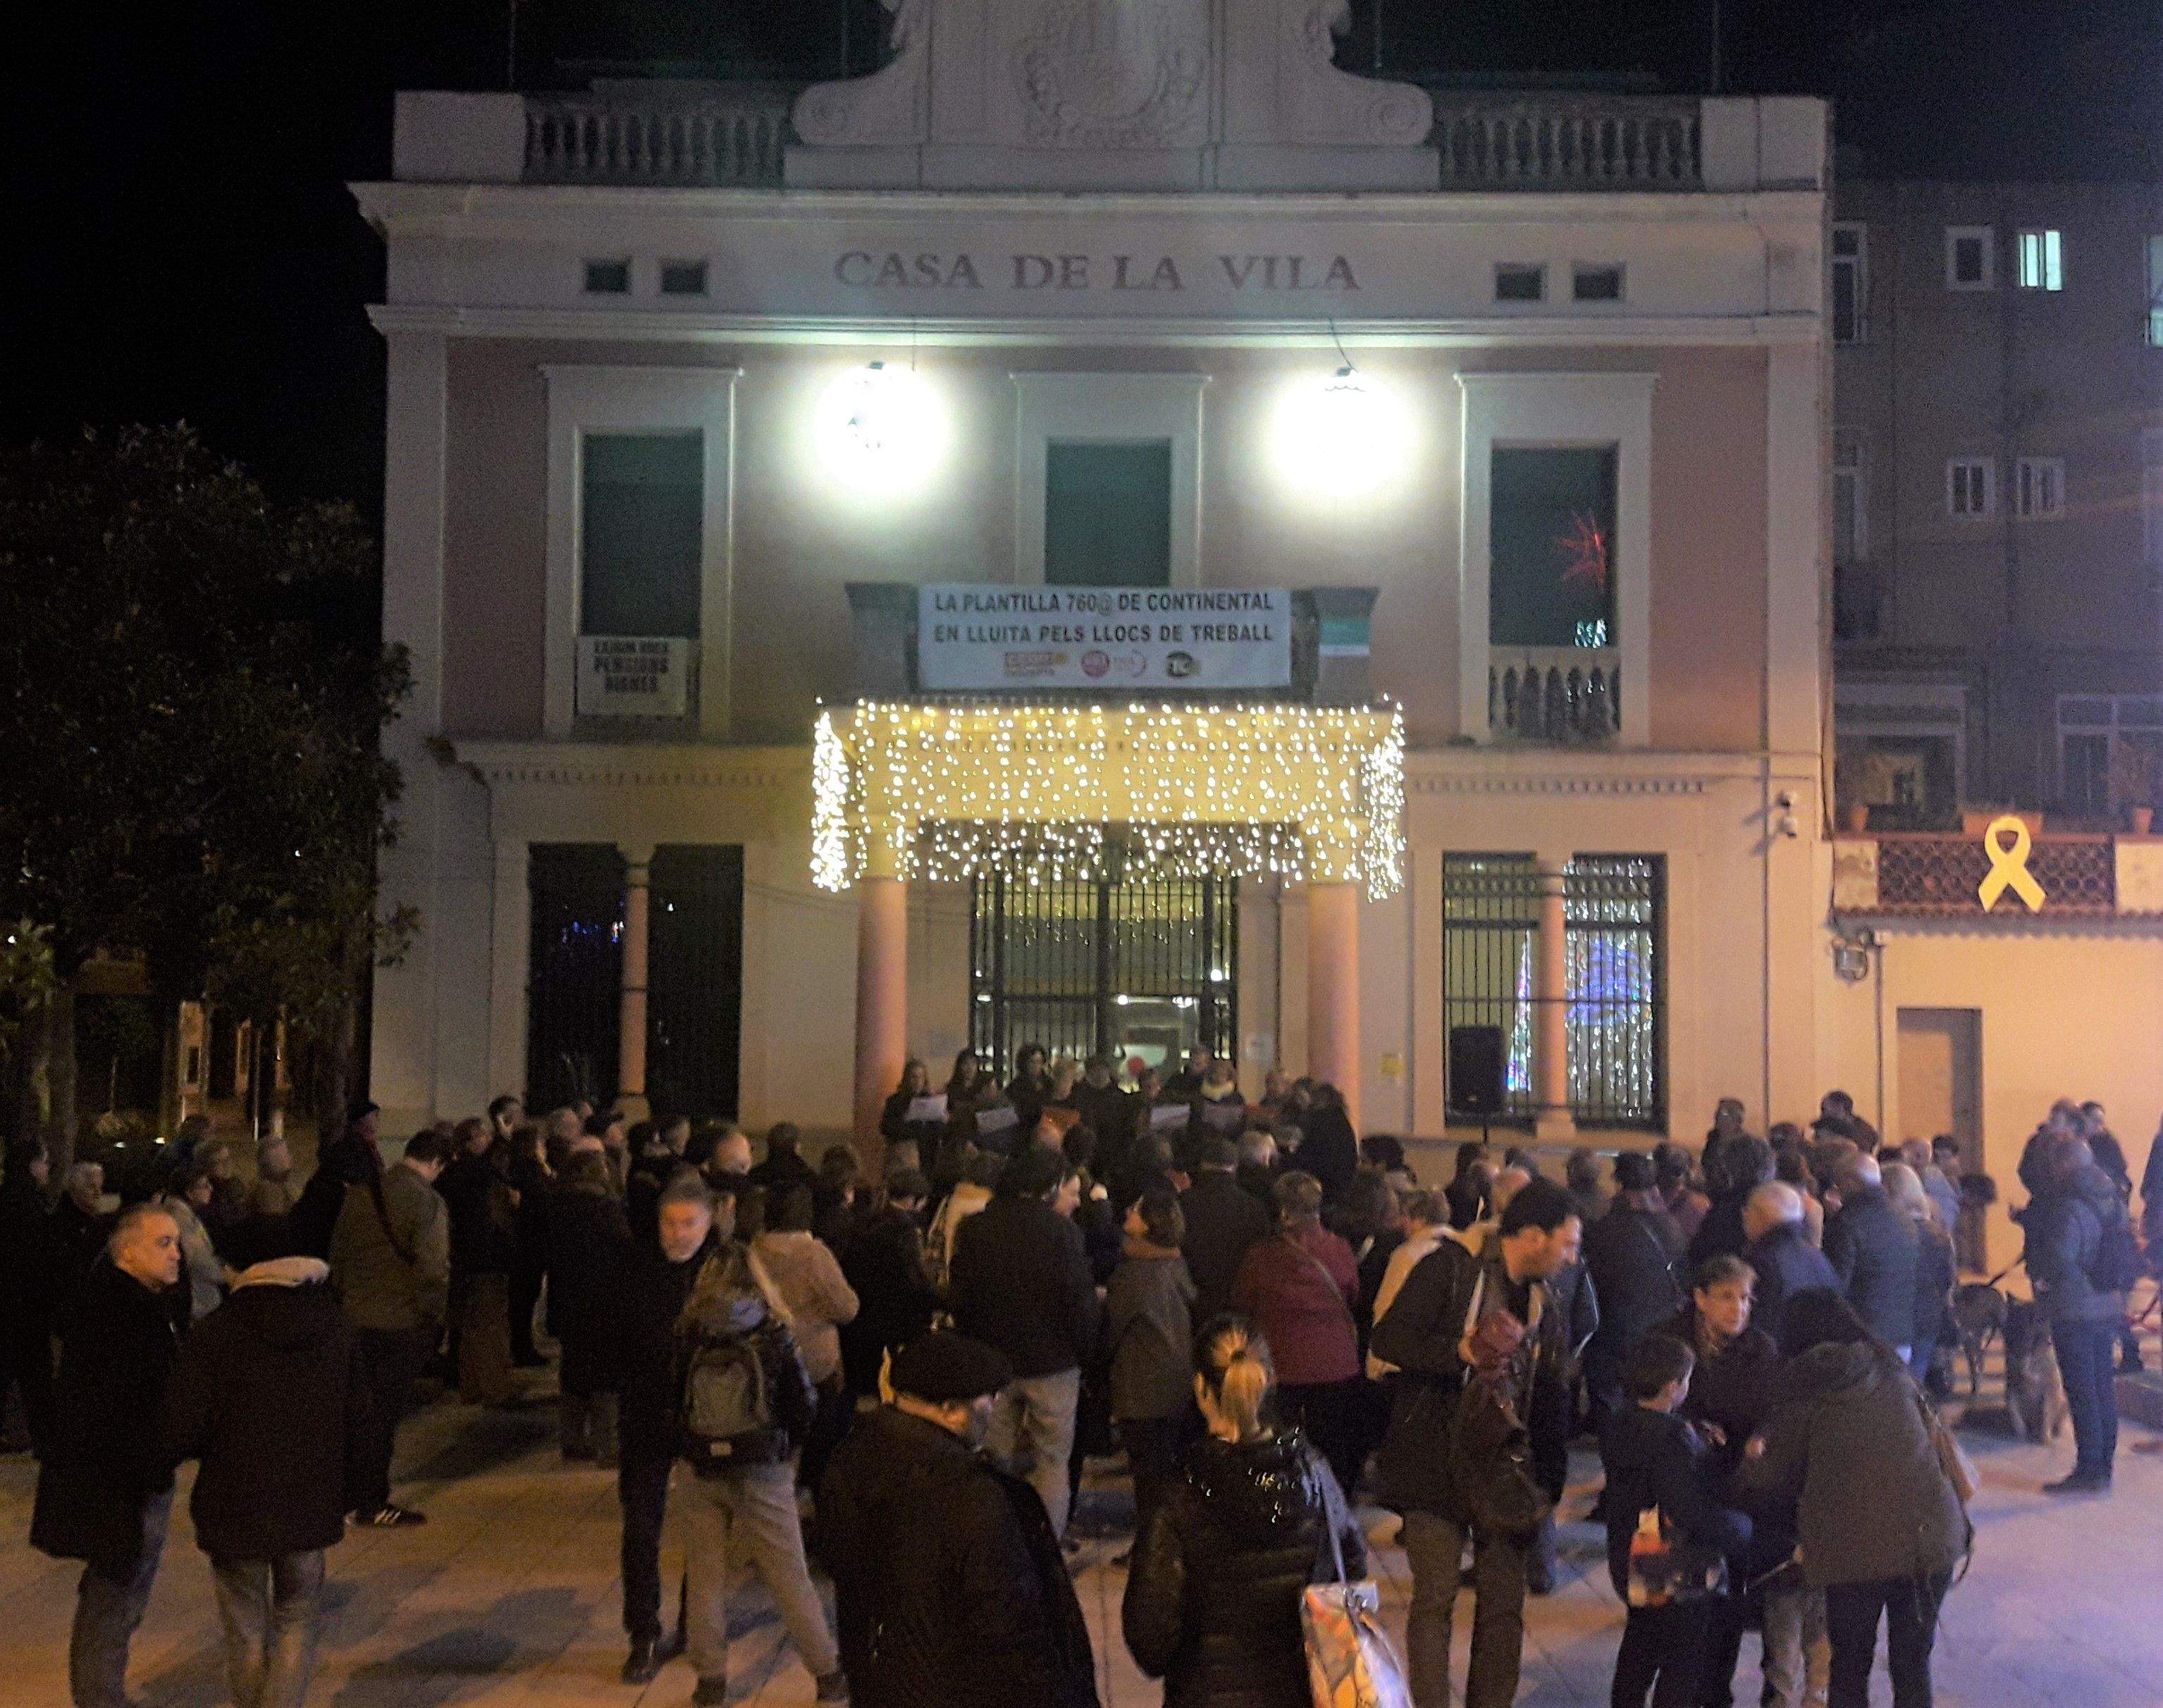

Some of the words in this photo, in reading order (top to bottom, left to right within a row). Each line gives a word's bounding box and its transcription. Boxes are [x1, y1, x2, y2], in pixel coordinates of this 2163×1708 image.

[834, 252, 984, 288] CASA
[1010, 254, 1090, 290] DE
[1112, 255, 1184, 290] LA
[1219, 255, 1360, 290] VILA
[935, 593, 957, 612] LA
[963, 593, 1060, 612] PLANTILLA
[1119, 593, 1140, 612] DE
[1148, 592, 1274, 612] CONTINENTAL
[935, 624, 959, 643] EN
[968, 624, 1031, 643] LLUITA
[1039, 624, 1084, 643] PELS
[1093, 624, 1151, 643] LLOCS
[1160, 624, 1183, 643] DE
[1191, 624, 1274, 643] TREBALL
